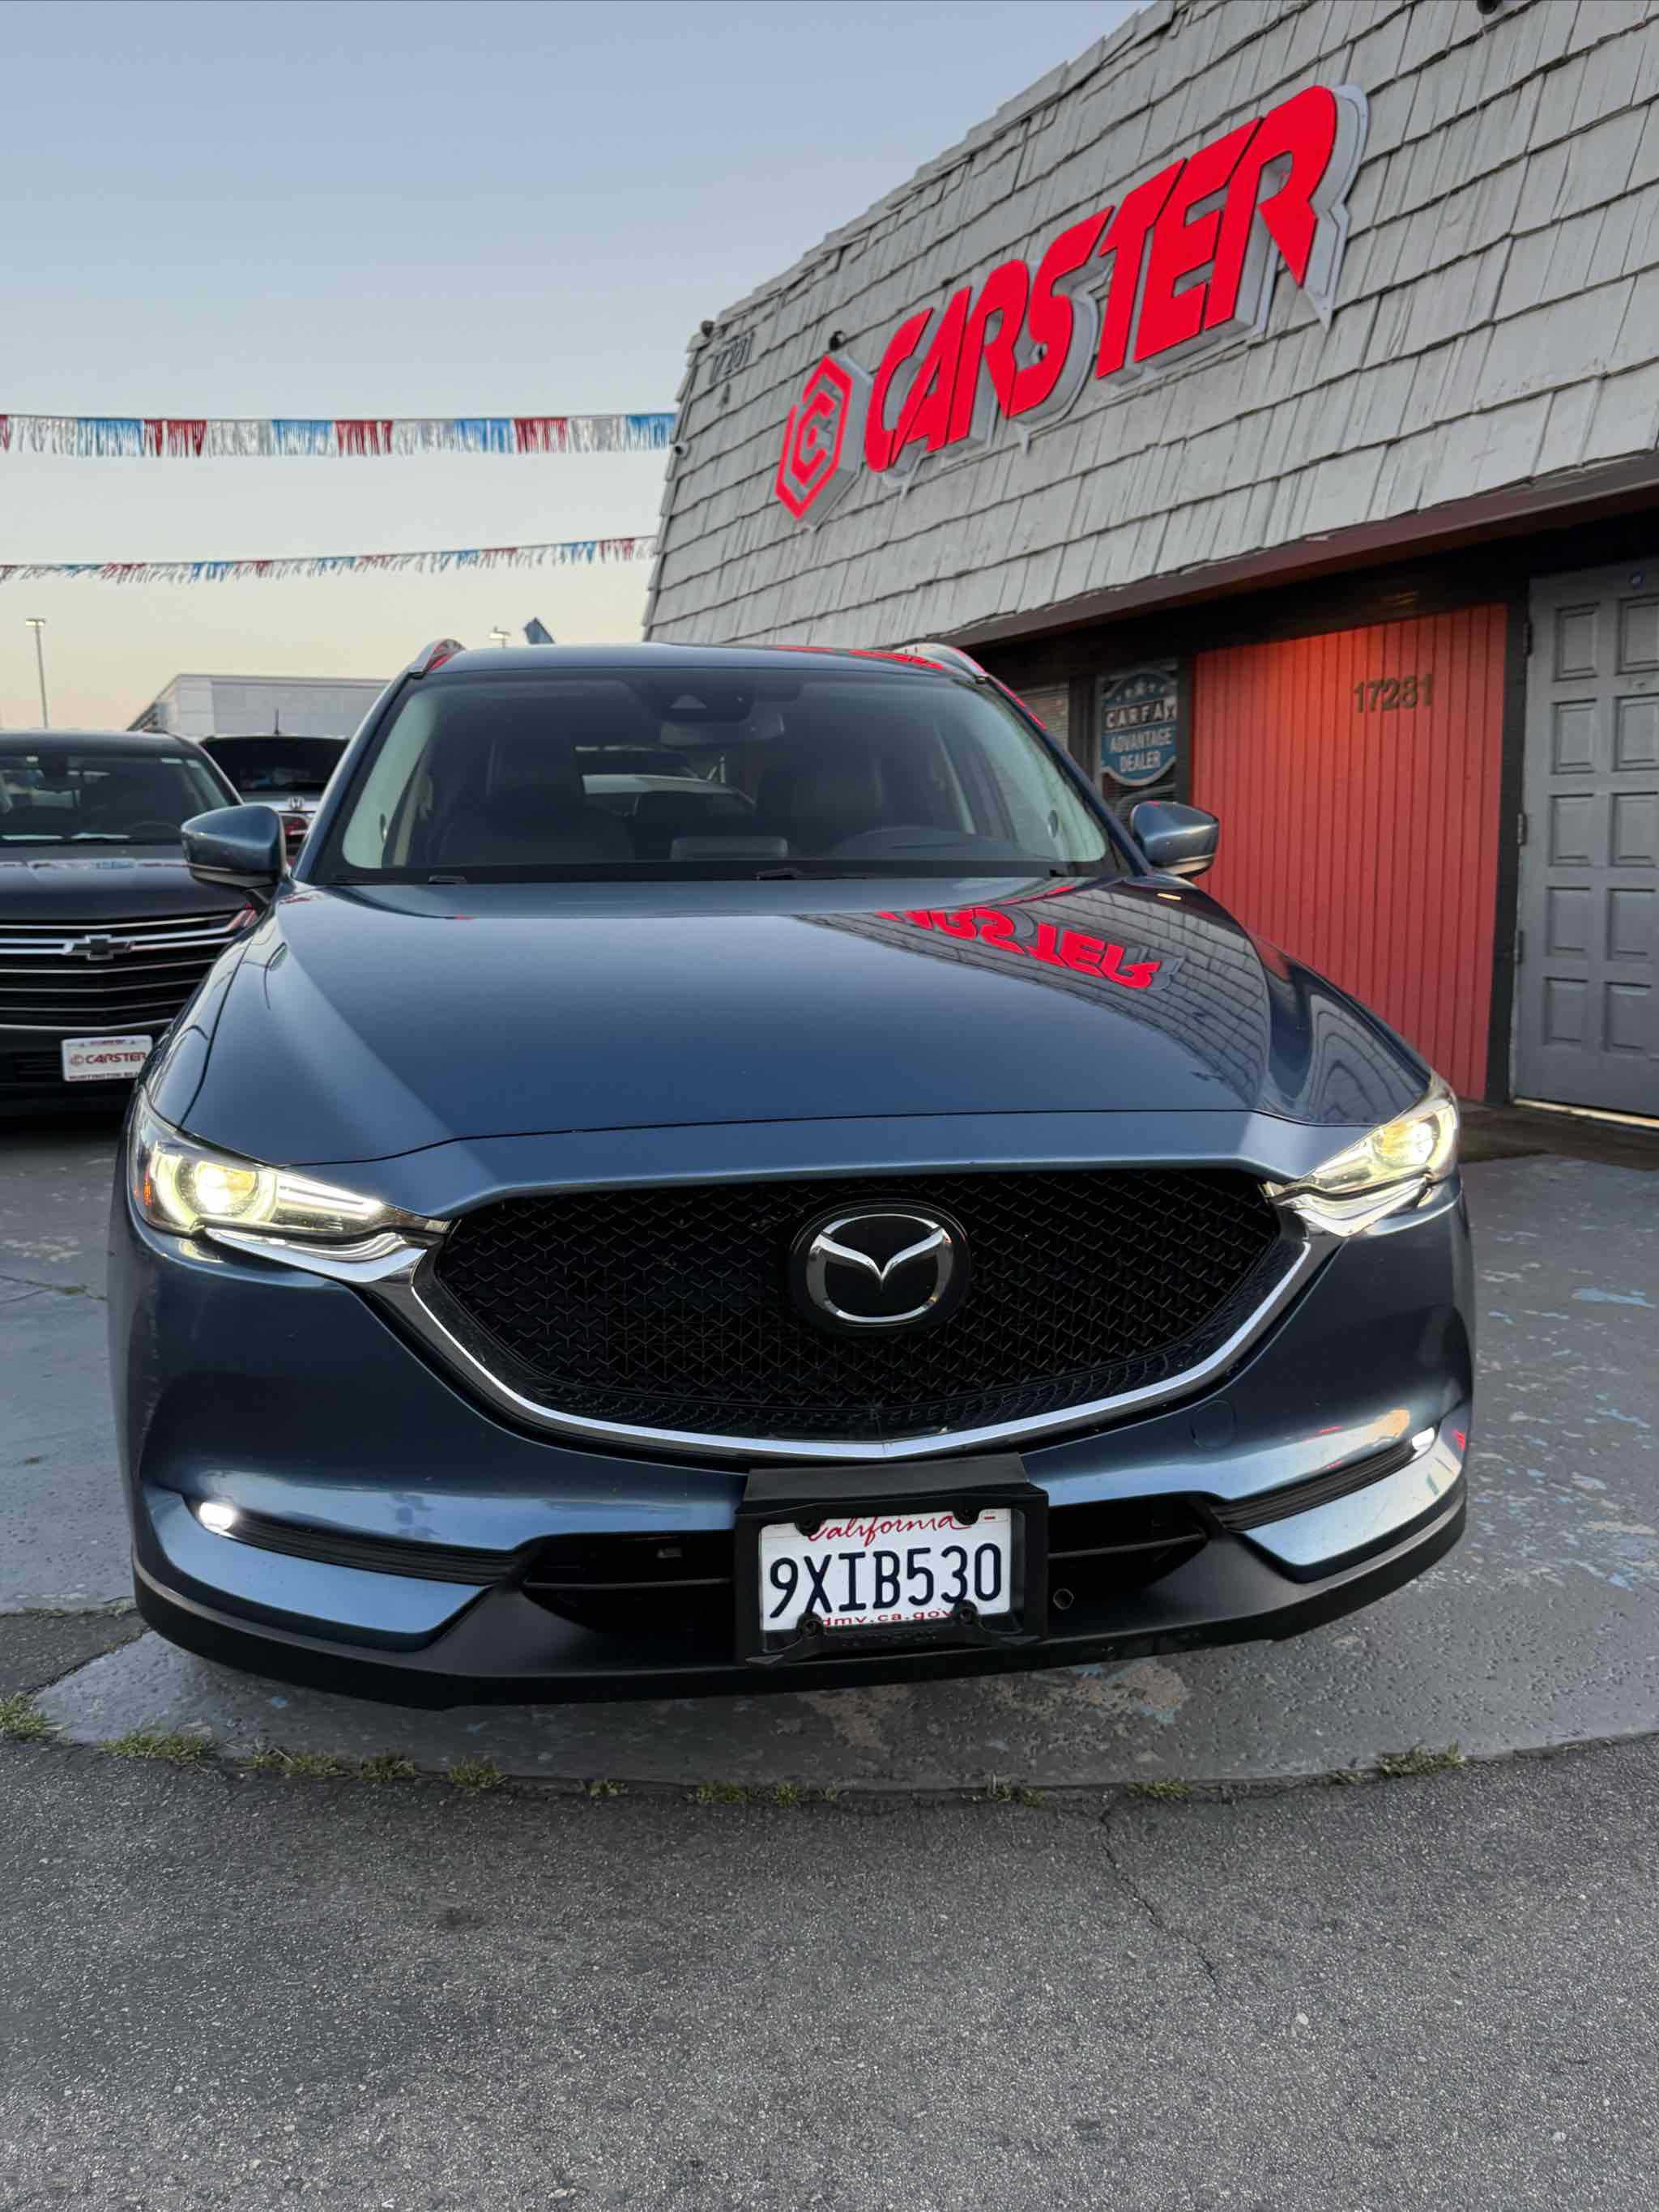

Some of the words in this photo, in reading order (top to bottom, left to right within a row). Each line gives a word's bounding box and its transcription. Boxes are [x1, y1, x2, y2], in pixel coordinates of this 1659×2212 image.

[864, 85, 1337, 473] CARSTER
[1352, 673, 1434, 714] 17281
[1106, 701, 1176, 728] CARFAX
[1108, 727, 1172, 753] ADVANTAGE
[1120, 750, 1162, 773] DEALER
[86, 1051, 147, 1065] CARSTER
[769, 1542, 1002, 1619] 9XIB530
